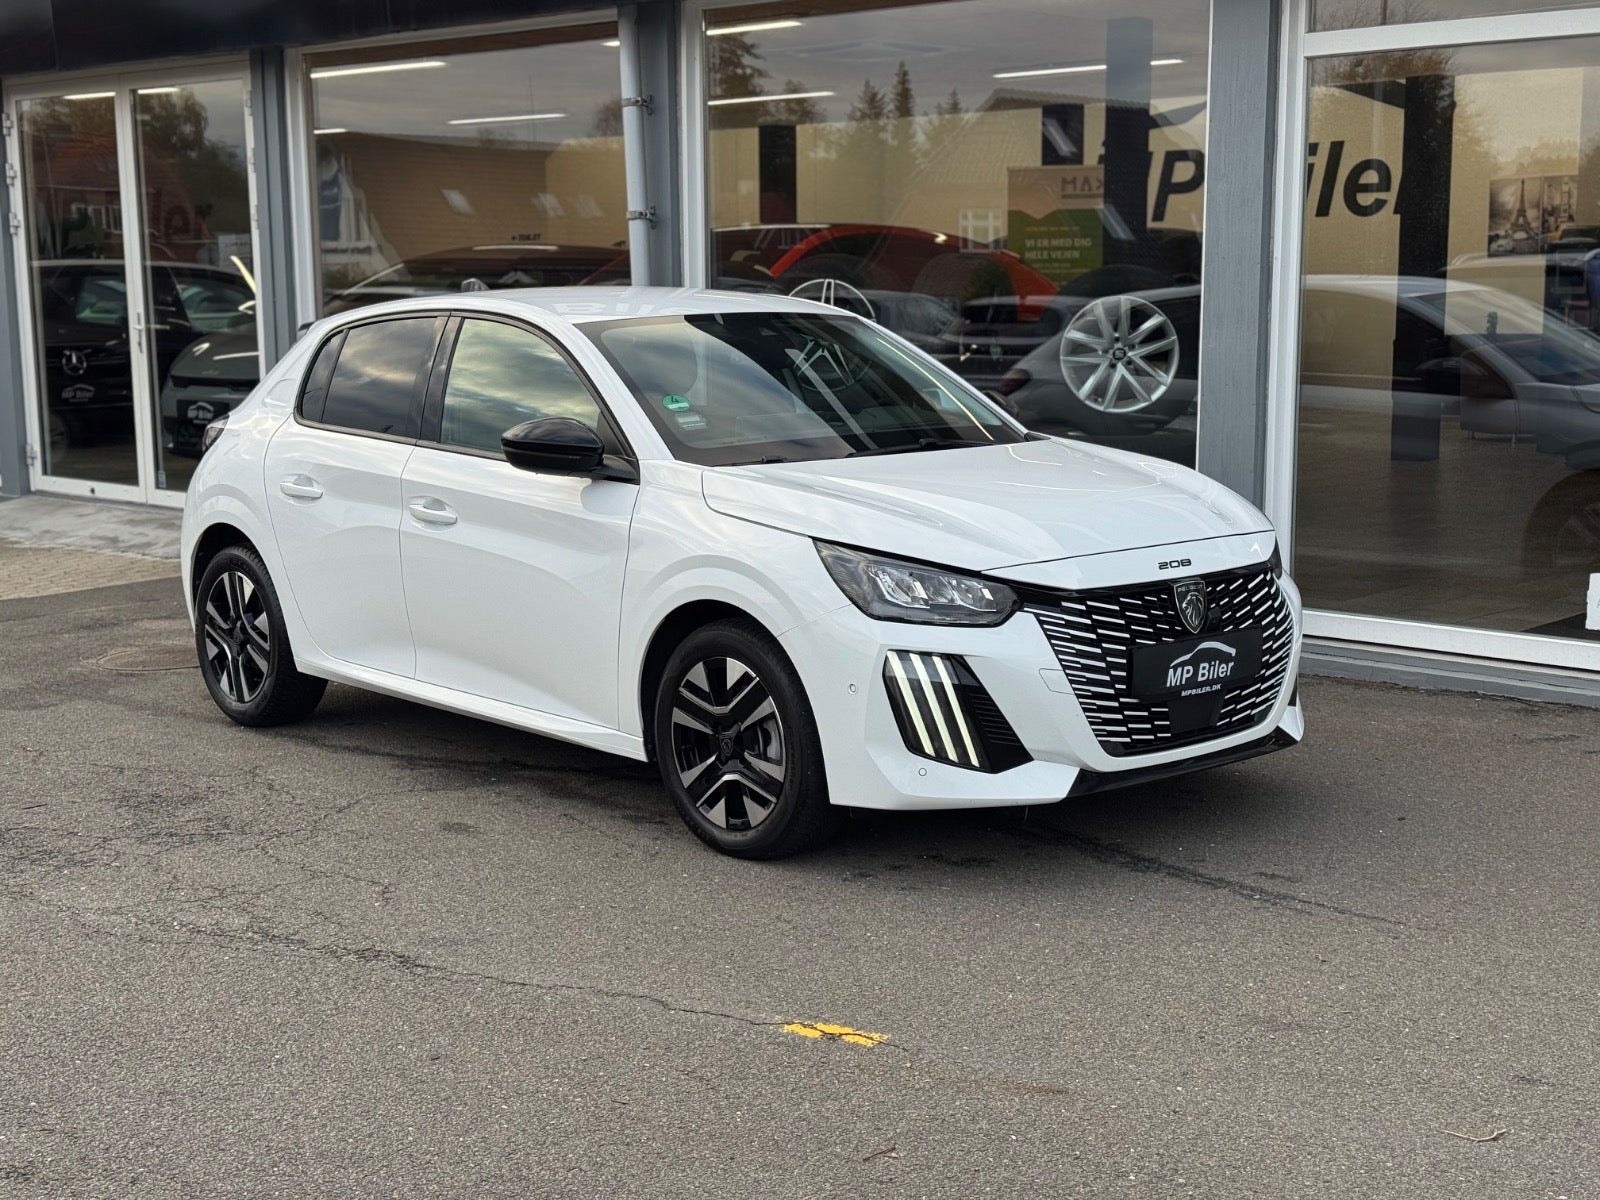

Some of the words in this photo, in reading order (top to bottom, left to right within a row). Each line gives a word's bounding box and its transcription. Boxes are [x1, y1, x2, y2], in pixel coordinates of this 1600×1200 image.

[1157, 558, 1192, 571] 208
[1166, 665, 1194, 688] MP
[1197, 659, 1235, 682] Biler
[1181, 683, 1222, 697] MPBILER.DK
